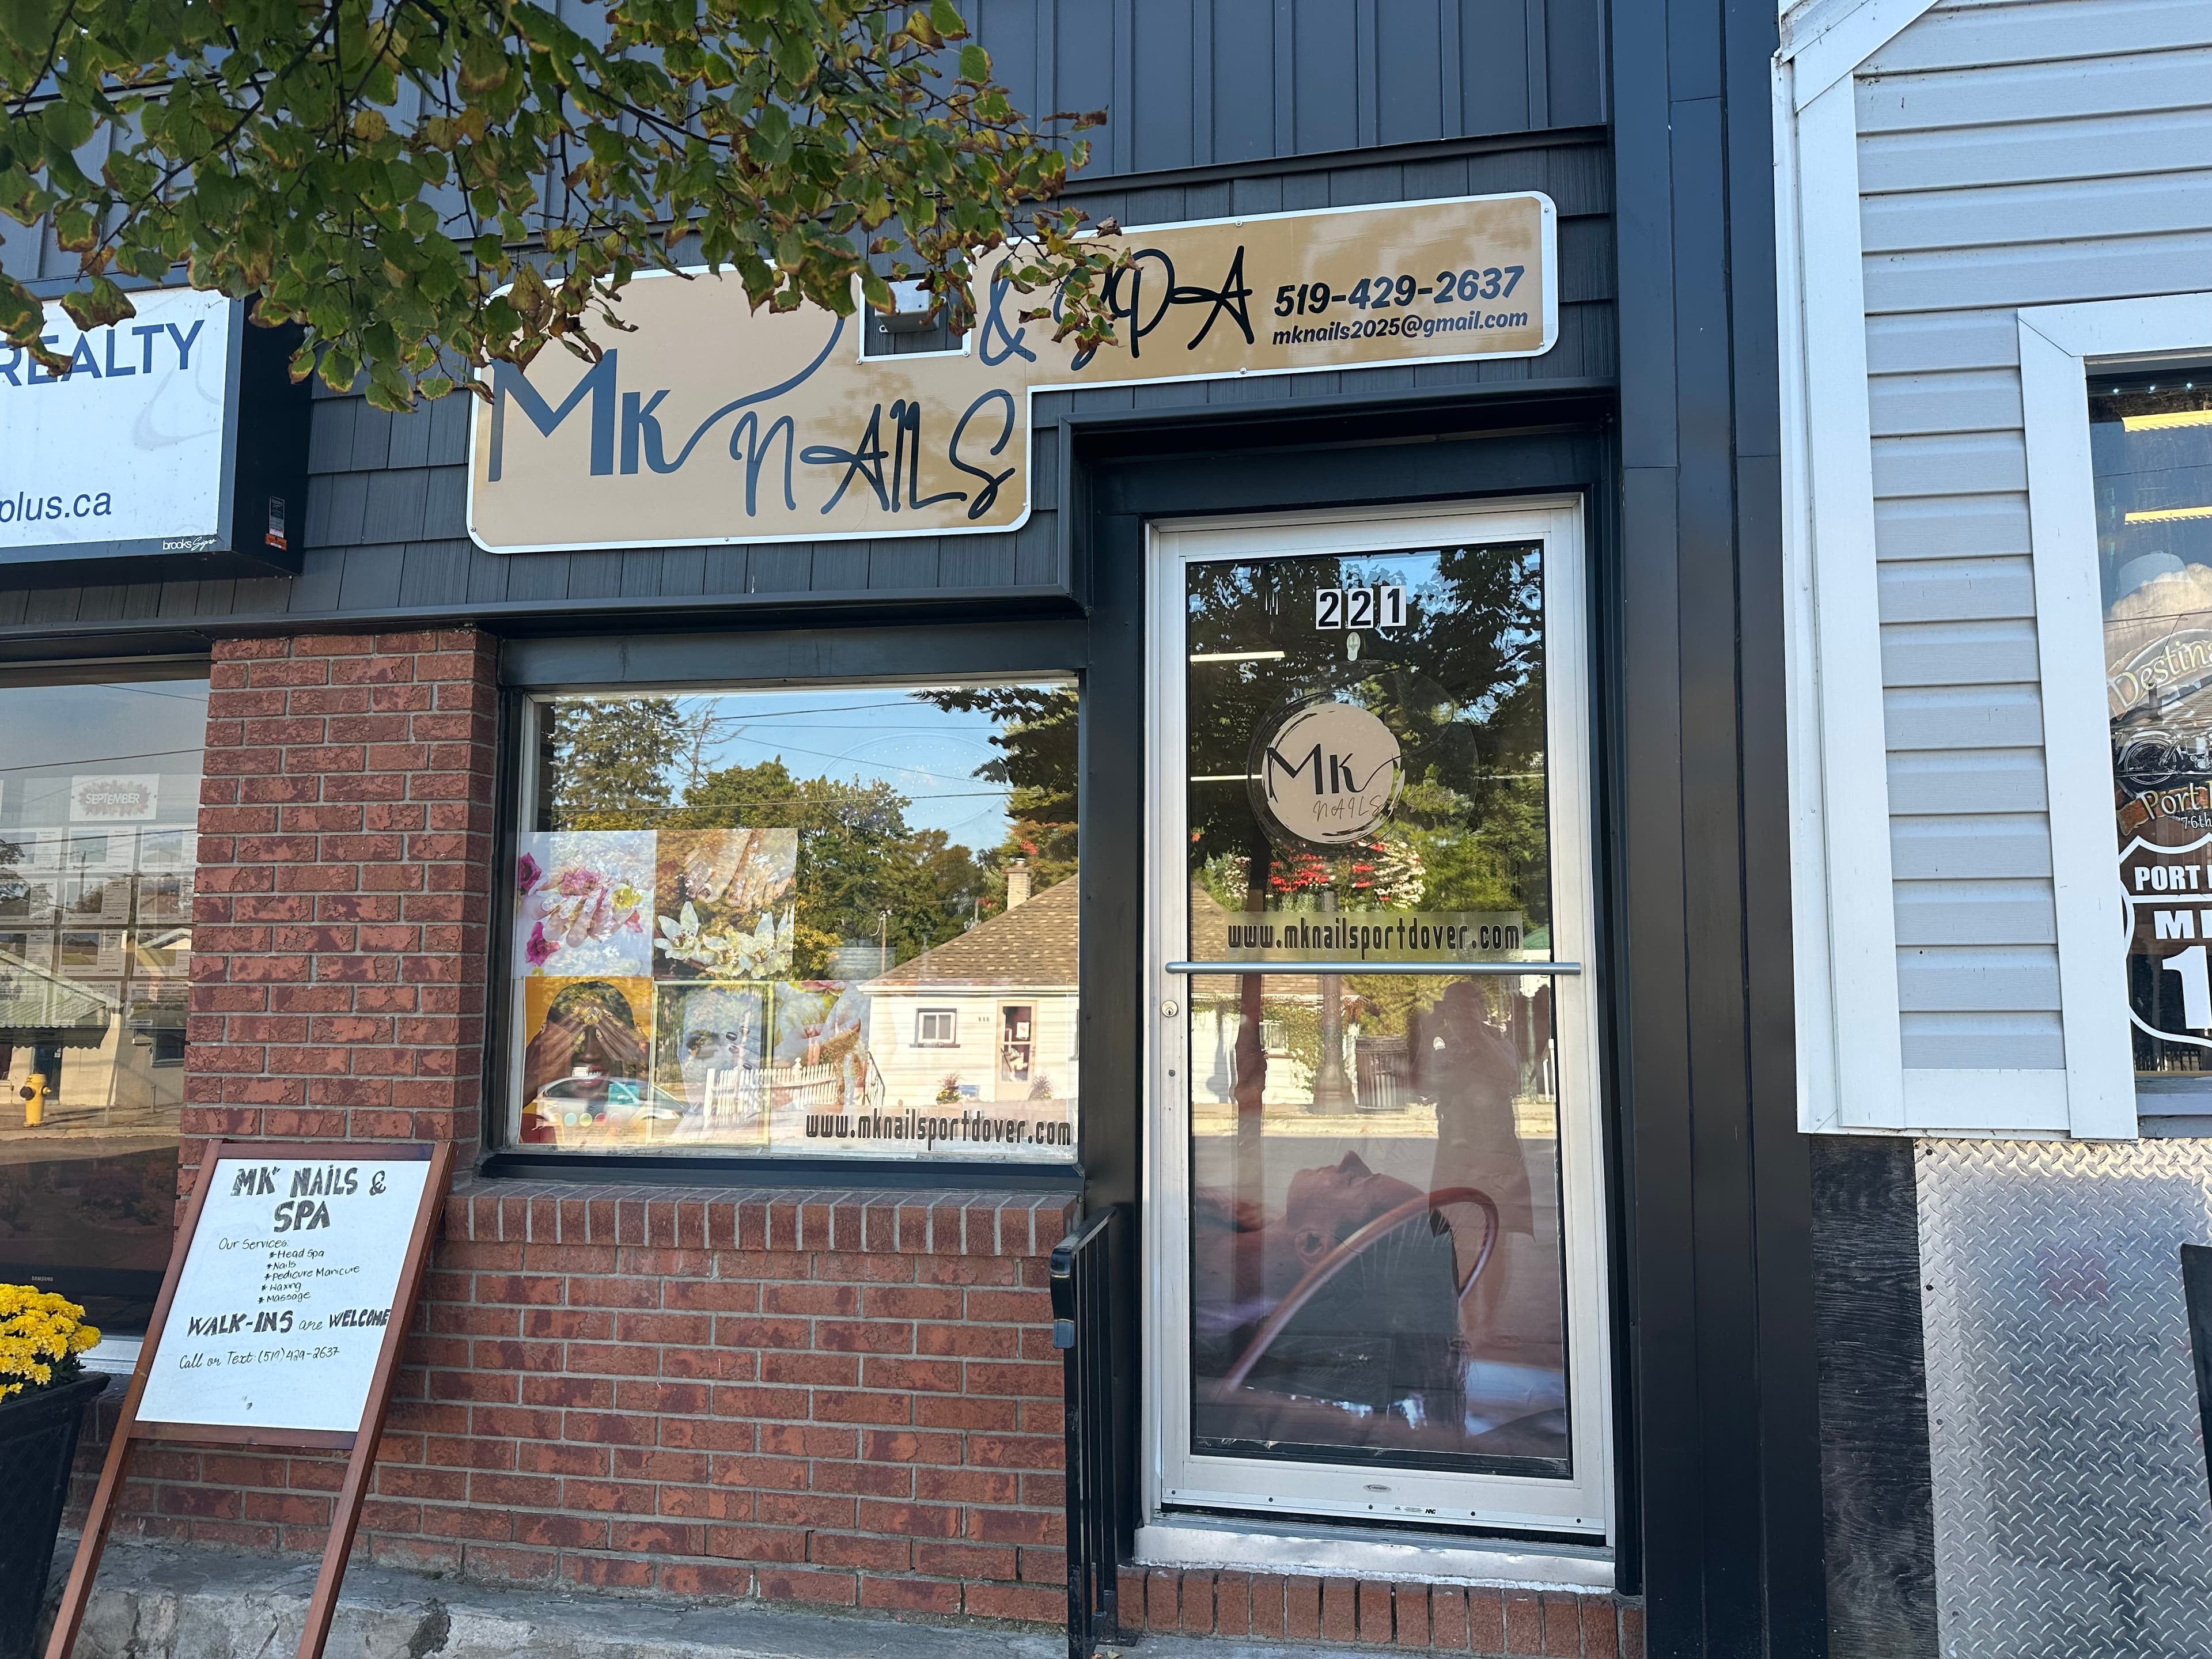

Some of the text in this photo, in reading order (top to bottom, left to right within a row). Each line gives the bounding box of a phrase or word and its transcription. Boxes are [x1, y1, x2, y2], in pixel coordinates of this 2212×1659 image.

[1274, 265, 1525, 317] 519-429-2637
[979, 259, 1037, 366] &
[1272, 310, 1528, 345] mknails2025@gmail.com
[162, 539, 192, 550] brooks
[1317, 586, 1404, 628] 221
[85, 792, 141, 805] SEPTEMBER
[2139, 782, 2202, 820] Port
[2181, 812, 2212, 830] 76th
[2134, 865, 2200, 891] PORT
[1228, 918, 1520, 960] www.mknailsportdover.com
[806, 1108, 1071, 1151] www.mknailsportdover.com
[274, 1200, 331, 1233] SPA
[218, 1238, 240, 1250] Our
[187, 1308, 392, 1337] WALK-INS are WELCOME
[179, 1353, 202, 1369] Call
[207, 1357, 222, 1367] or
